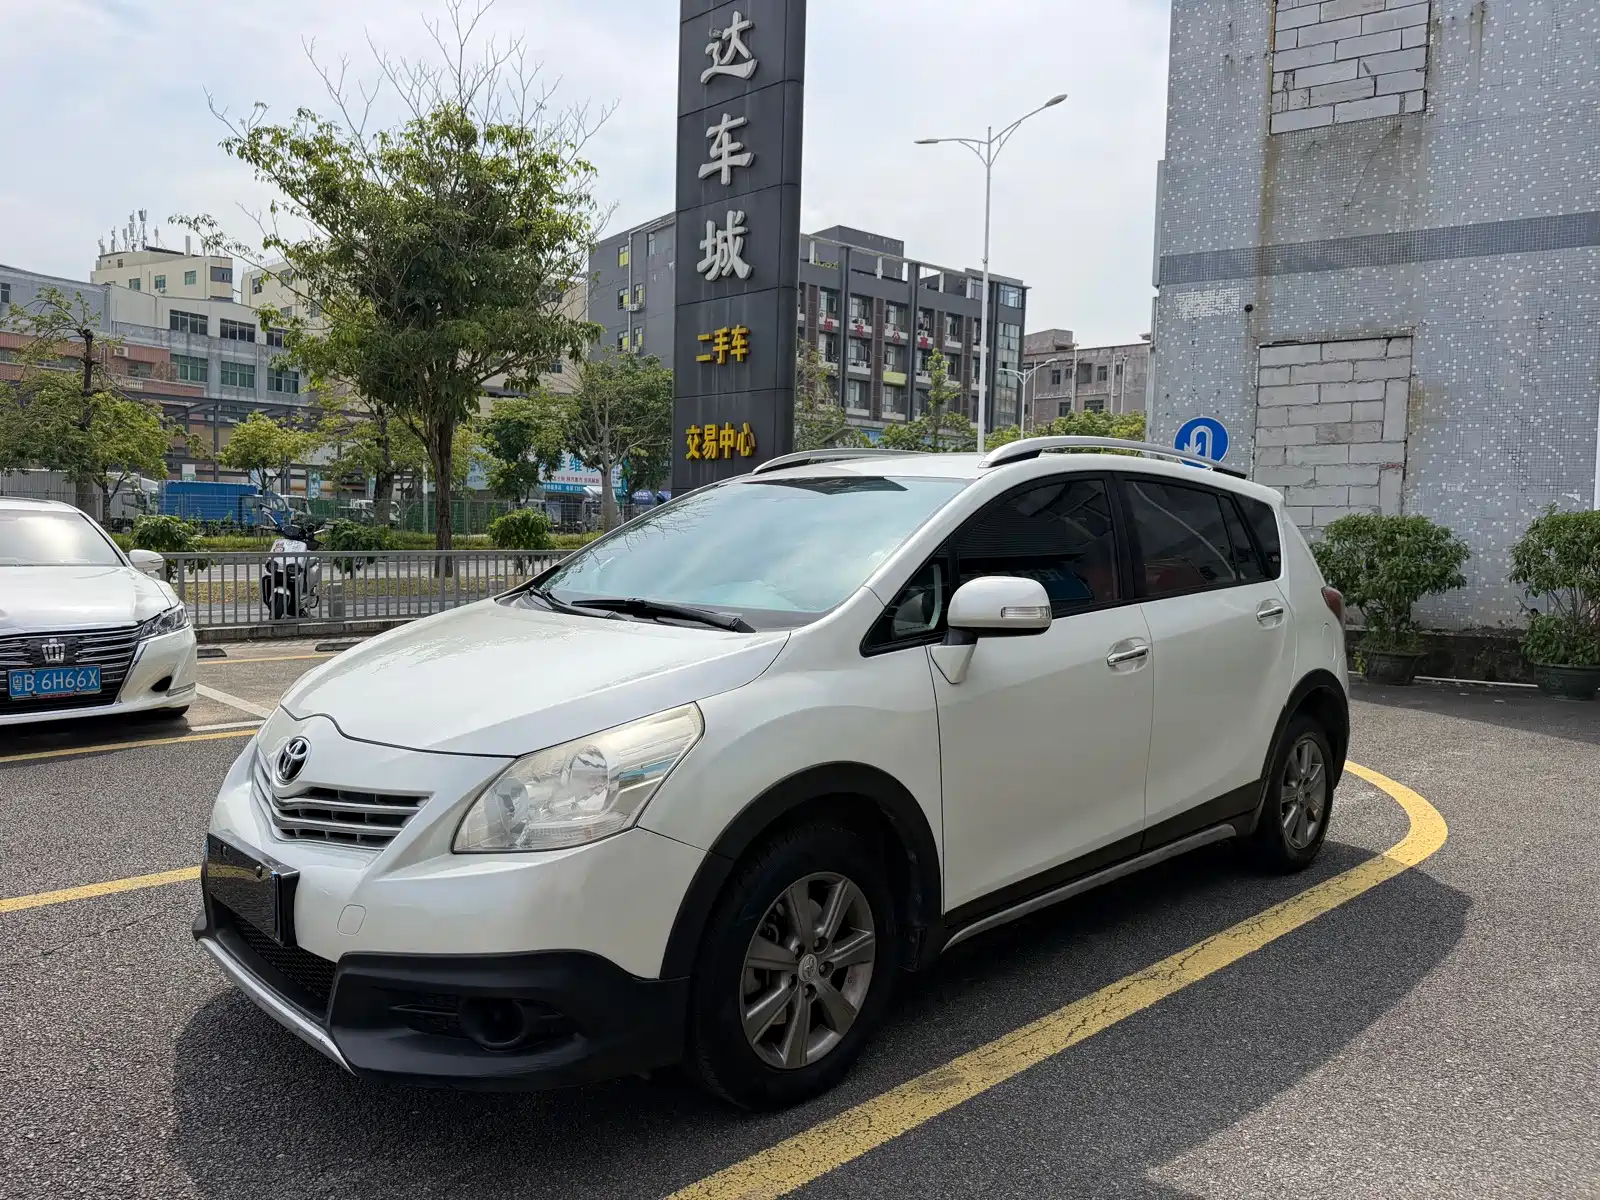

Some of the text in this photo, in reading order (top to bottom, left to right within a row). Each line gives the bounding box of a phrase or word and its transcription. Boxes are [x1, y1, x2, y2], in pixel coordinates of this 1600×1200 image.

[697, 10, 758, 281] 达车城
[695, 324, 750, 366] 二手车
[685, 421, 756, 460] 交易中心
